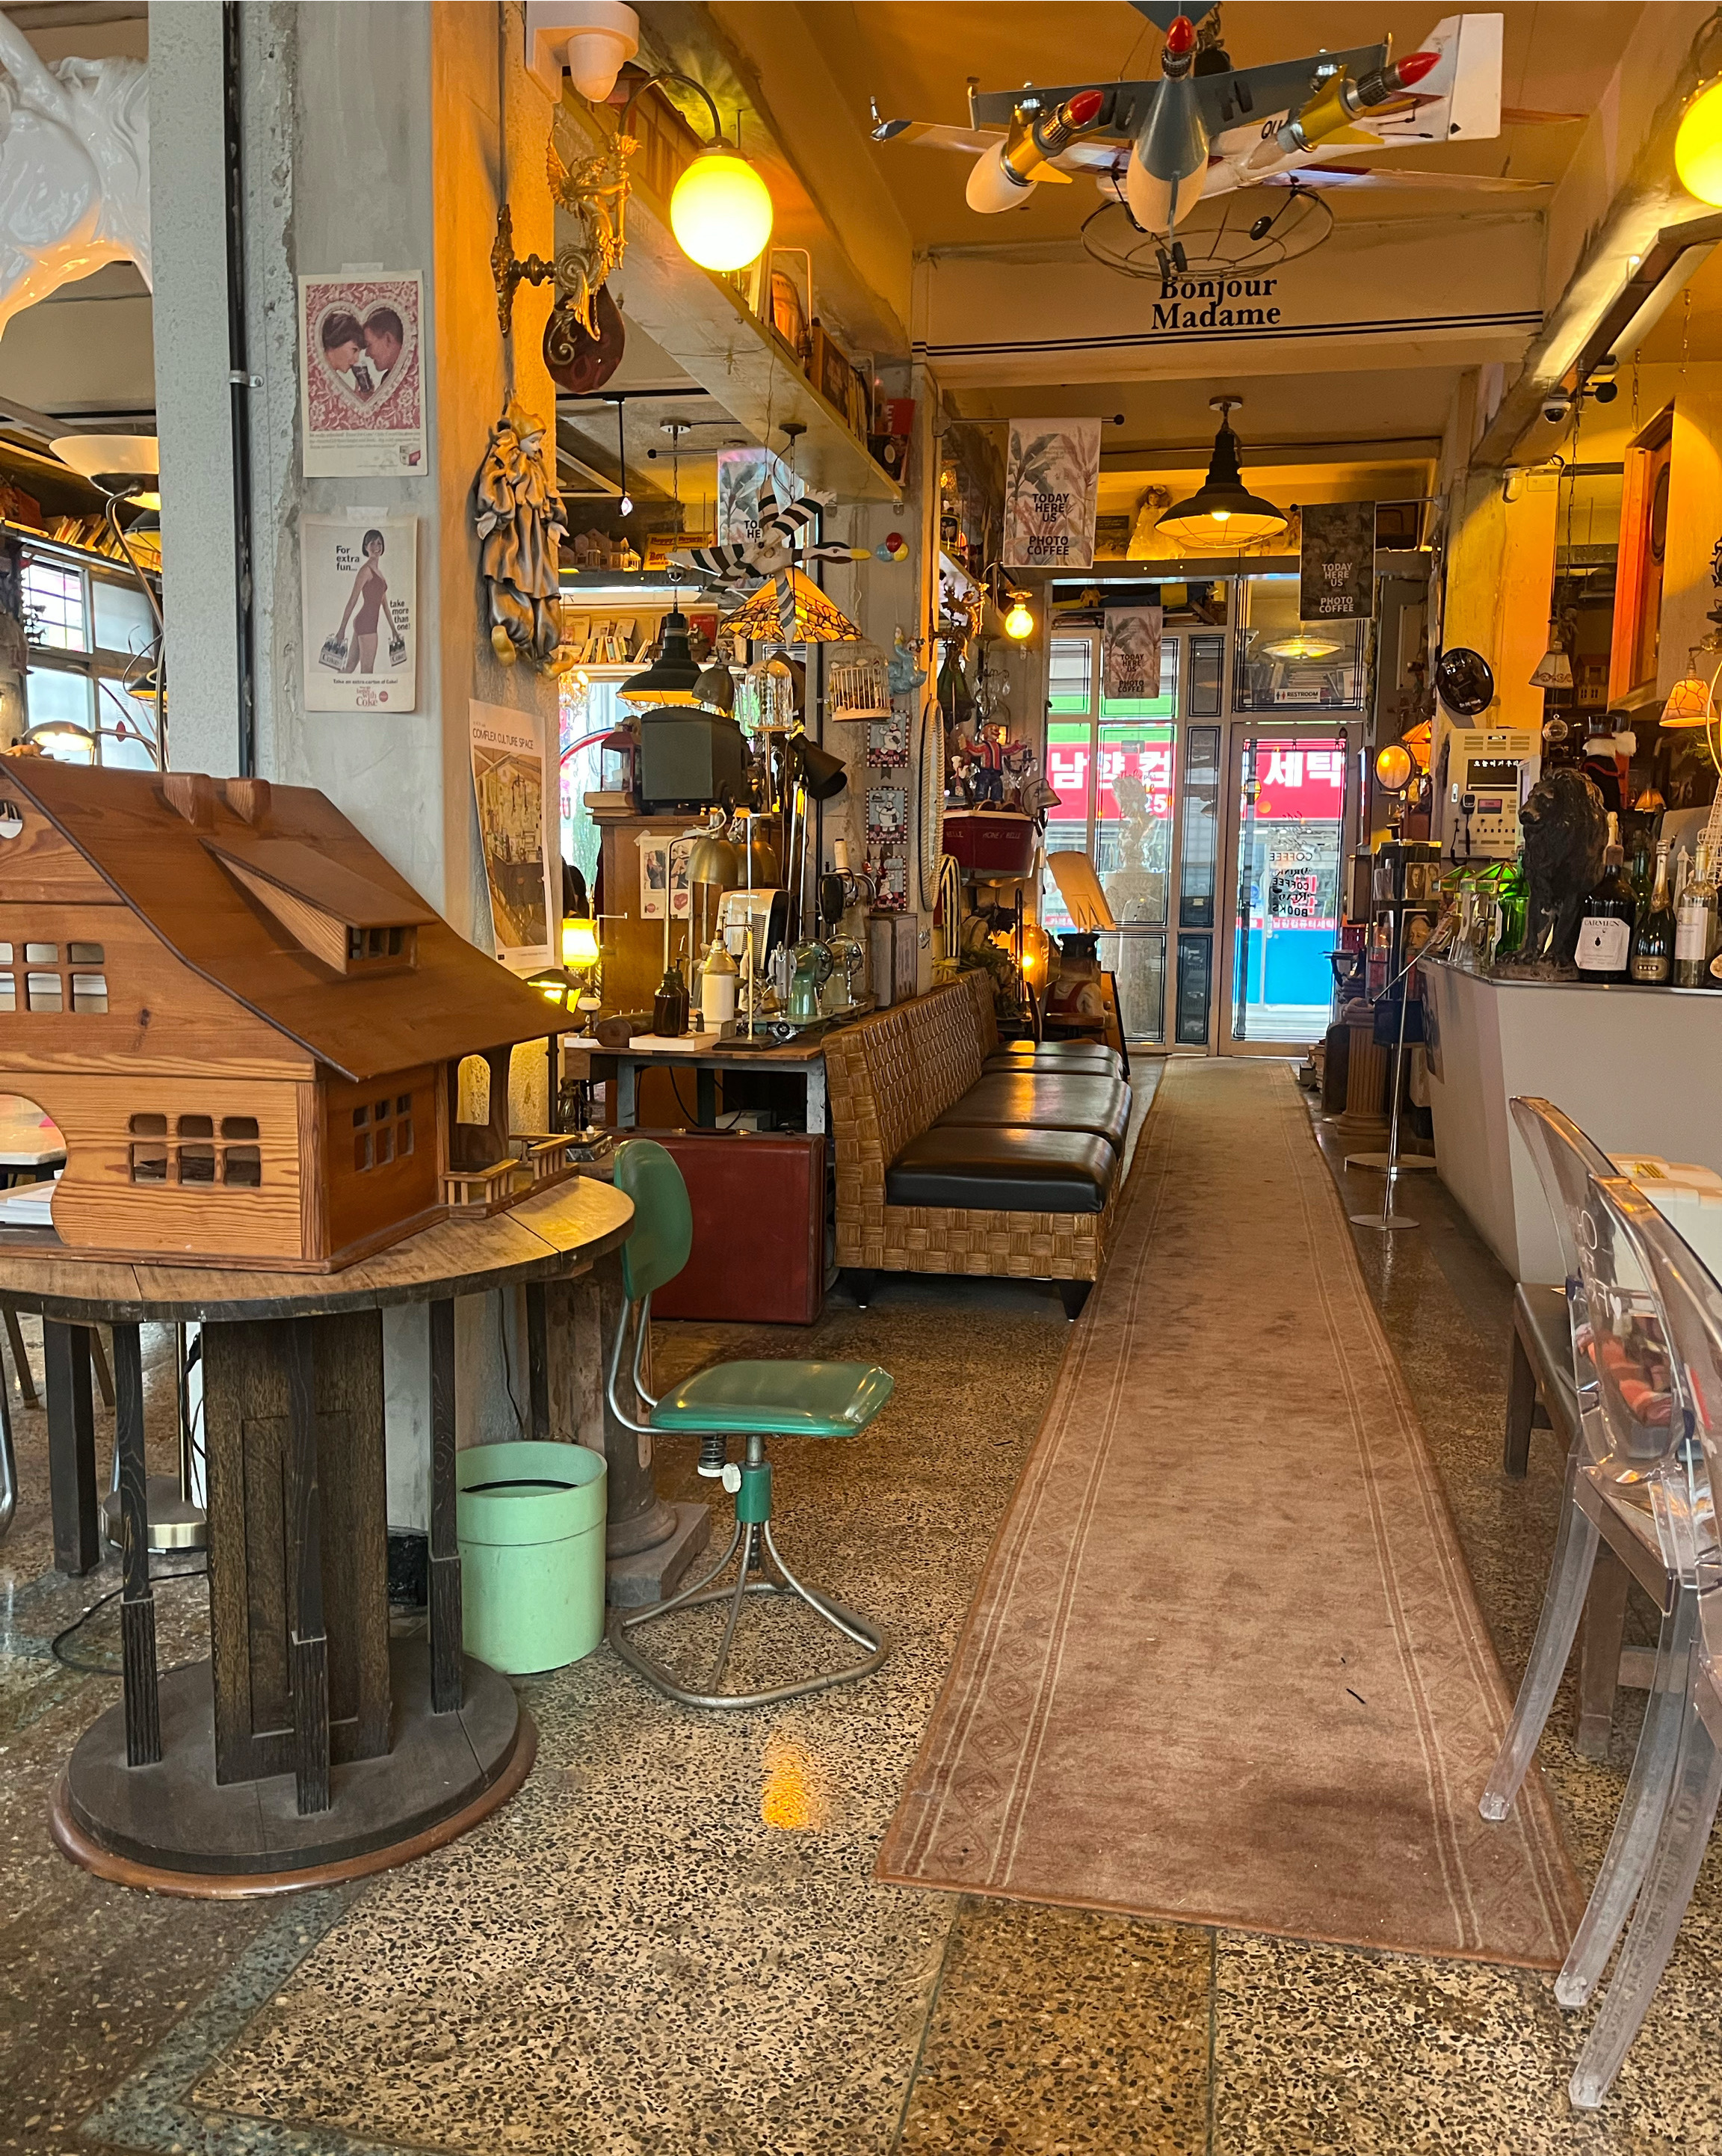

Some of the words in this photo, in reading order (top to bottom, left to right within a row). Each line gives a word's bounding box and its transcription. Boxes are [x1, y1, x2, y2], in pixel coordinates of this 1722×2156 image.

[1160, 276, 1277, 305] Bonjour
[1151, 302, 1281, 330] Madame
[1032, 493, 1070, 503] TODAY
[1035, 503, 1065, 513] HERE
[1042, 513, 1057, 522] US
[747, 529, 761, 538] HE
[1029, 536, 1069, 546] PHOTO
[336, 545, 351, 554] For
[1027, 546, 1070, 555] COFFEE
[1322, 562, 1353, 571] TODAY
[1324, 570, 1349, 579] HERE
[1330, 579, 1343, 587] US
[390, 599, 405, 608] take
[1320, 597, 1353, 605] PHOTO
[1318, 604, 1354, 613] COFFEE
[395, 615, 409, 623] than
[356, 694, 378, 706] Coke
[472, 727, 497, 742] COMPLEX
[519, 737, 534, 750] SPACE
[1263, 751, 1342, 787] 세탁
